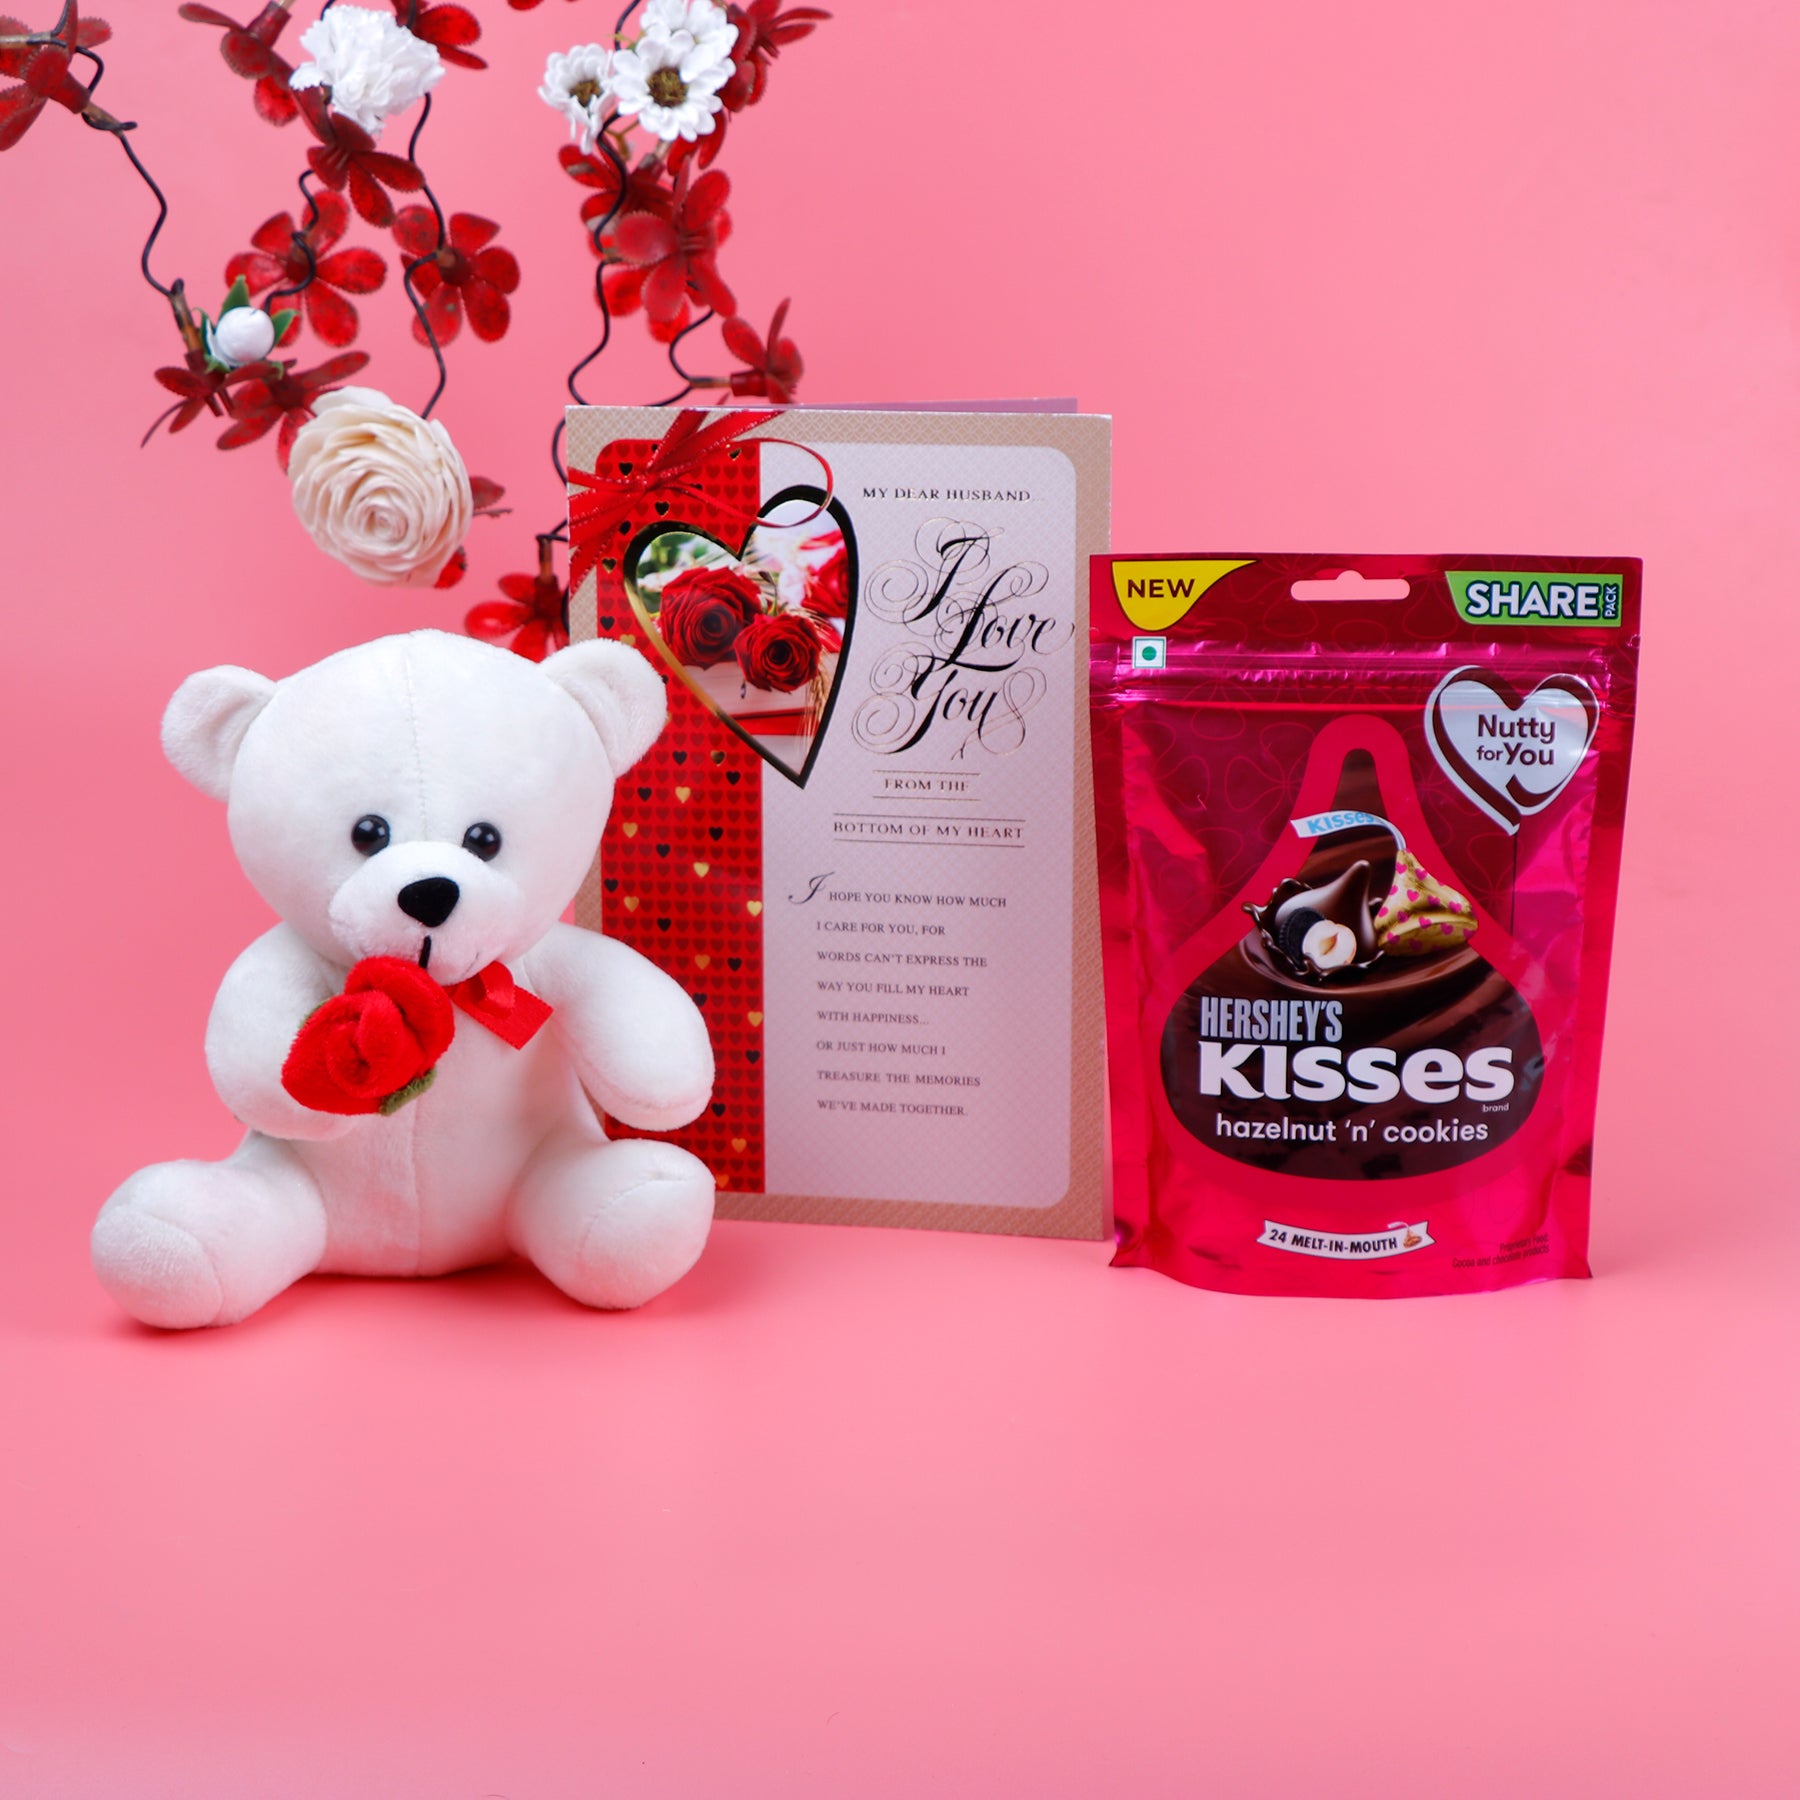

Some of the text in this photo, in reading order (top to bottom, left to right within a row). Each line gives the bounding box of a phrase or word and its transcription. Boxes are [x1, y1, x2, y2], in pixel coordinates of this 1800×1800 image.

[863, 487, 888, 498] MY
[894, 488, 940, 499] DEAR
[1127, 578, 1195, 598] NEW
[1465, 582, 1599, 618] SHARE
[1604, 585, 1618, 618] PACK
[938, 562, 1073, 672] Love
[1477, 714, 1556, 744] Nutty
[1477, 742, 1554, 766] for You
[884, 778, 969, 793] FROM THE
[834, 821, 1025, 839] BOTTOM OF MY HEART
[789, 871, 1007, 908] I HOPE YOU KNOW HOW MUCH
[816, 921, 946, 936] I CARE FOR YOU, FOR
[817, 951, 988, 968] WORDS CAN'T EXPRESS THE
[817, 981, 970, 997] WAY YOU FILL MY HEART
[817, 1010, 929, 1025] WITH HAPPINESS...
[1201, 996, 1343, 1042] HERSHEY'S
[816, 1040, 833, 1051] OR
[837, 1041, 865, 1052] JUST
[868, 1042, 898, 1053] HOW
[900, 1044, 938, 1055] MUCH
[817, 1070, 981, 1087] TREASURE THE MEMORIES
[817, 1100, 968, 1116] WE'VE MADE TOGETHER.
[1482, 1103, 1509, 1113] brand
[1216, 1113, 1337, 1143] hazelnut
[1383, 1119, 1489, 1143] cookies
[1269, 1229, 1397, 1253] 24 MELT-IN-MOUTH
[1452, 1258, 1475, 1268] Cocoa
[1477, 1257, 1491, 1266] and
[1492, 1251, 1521, 1264] chocolate
